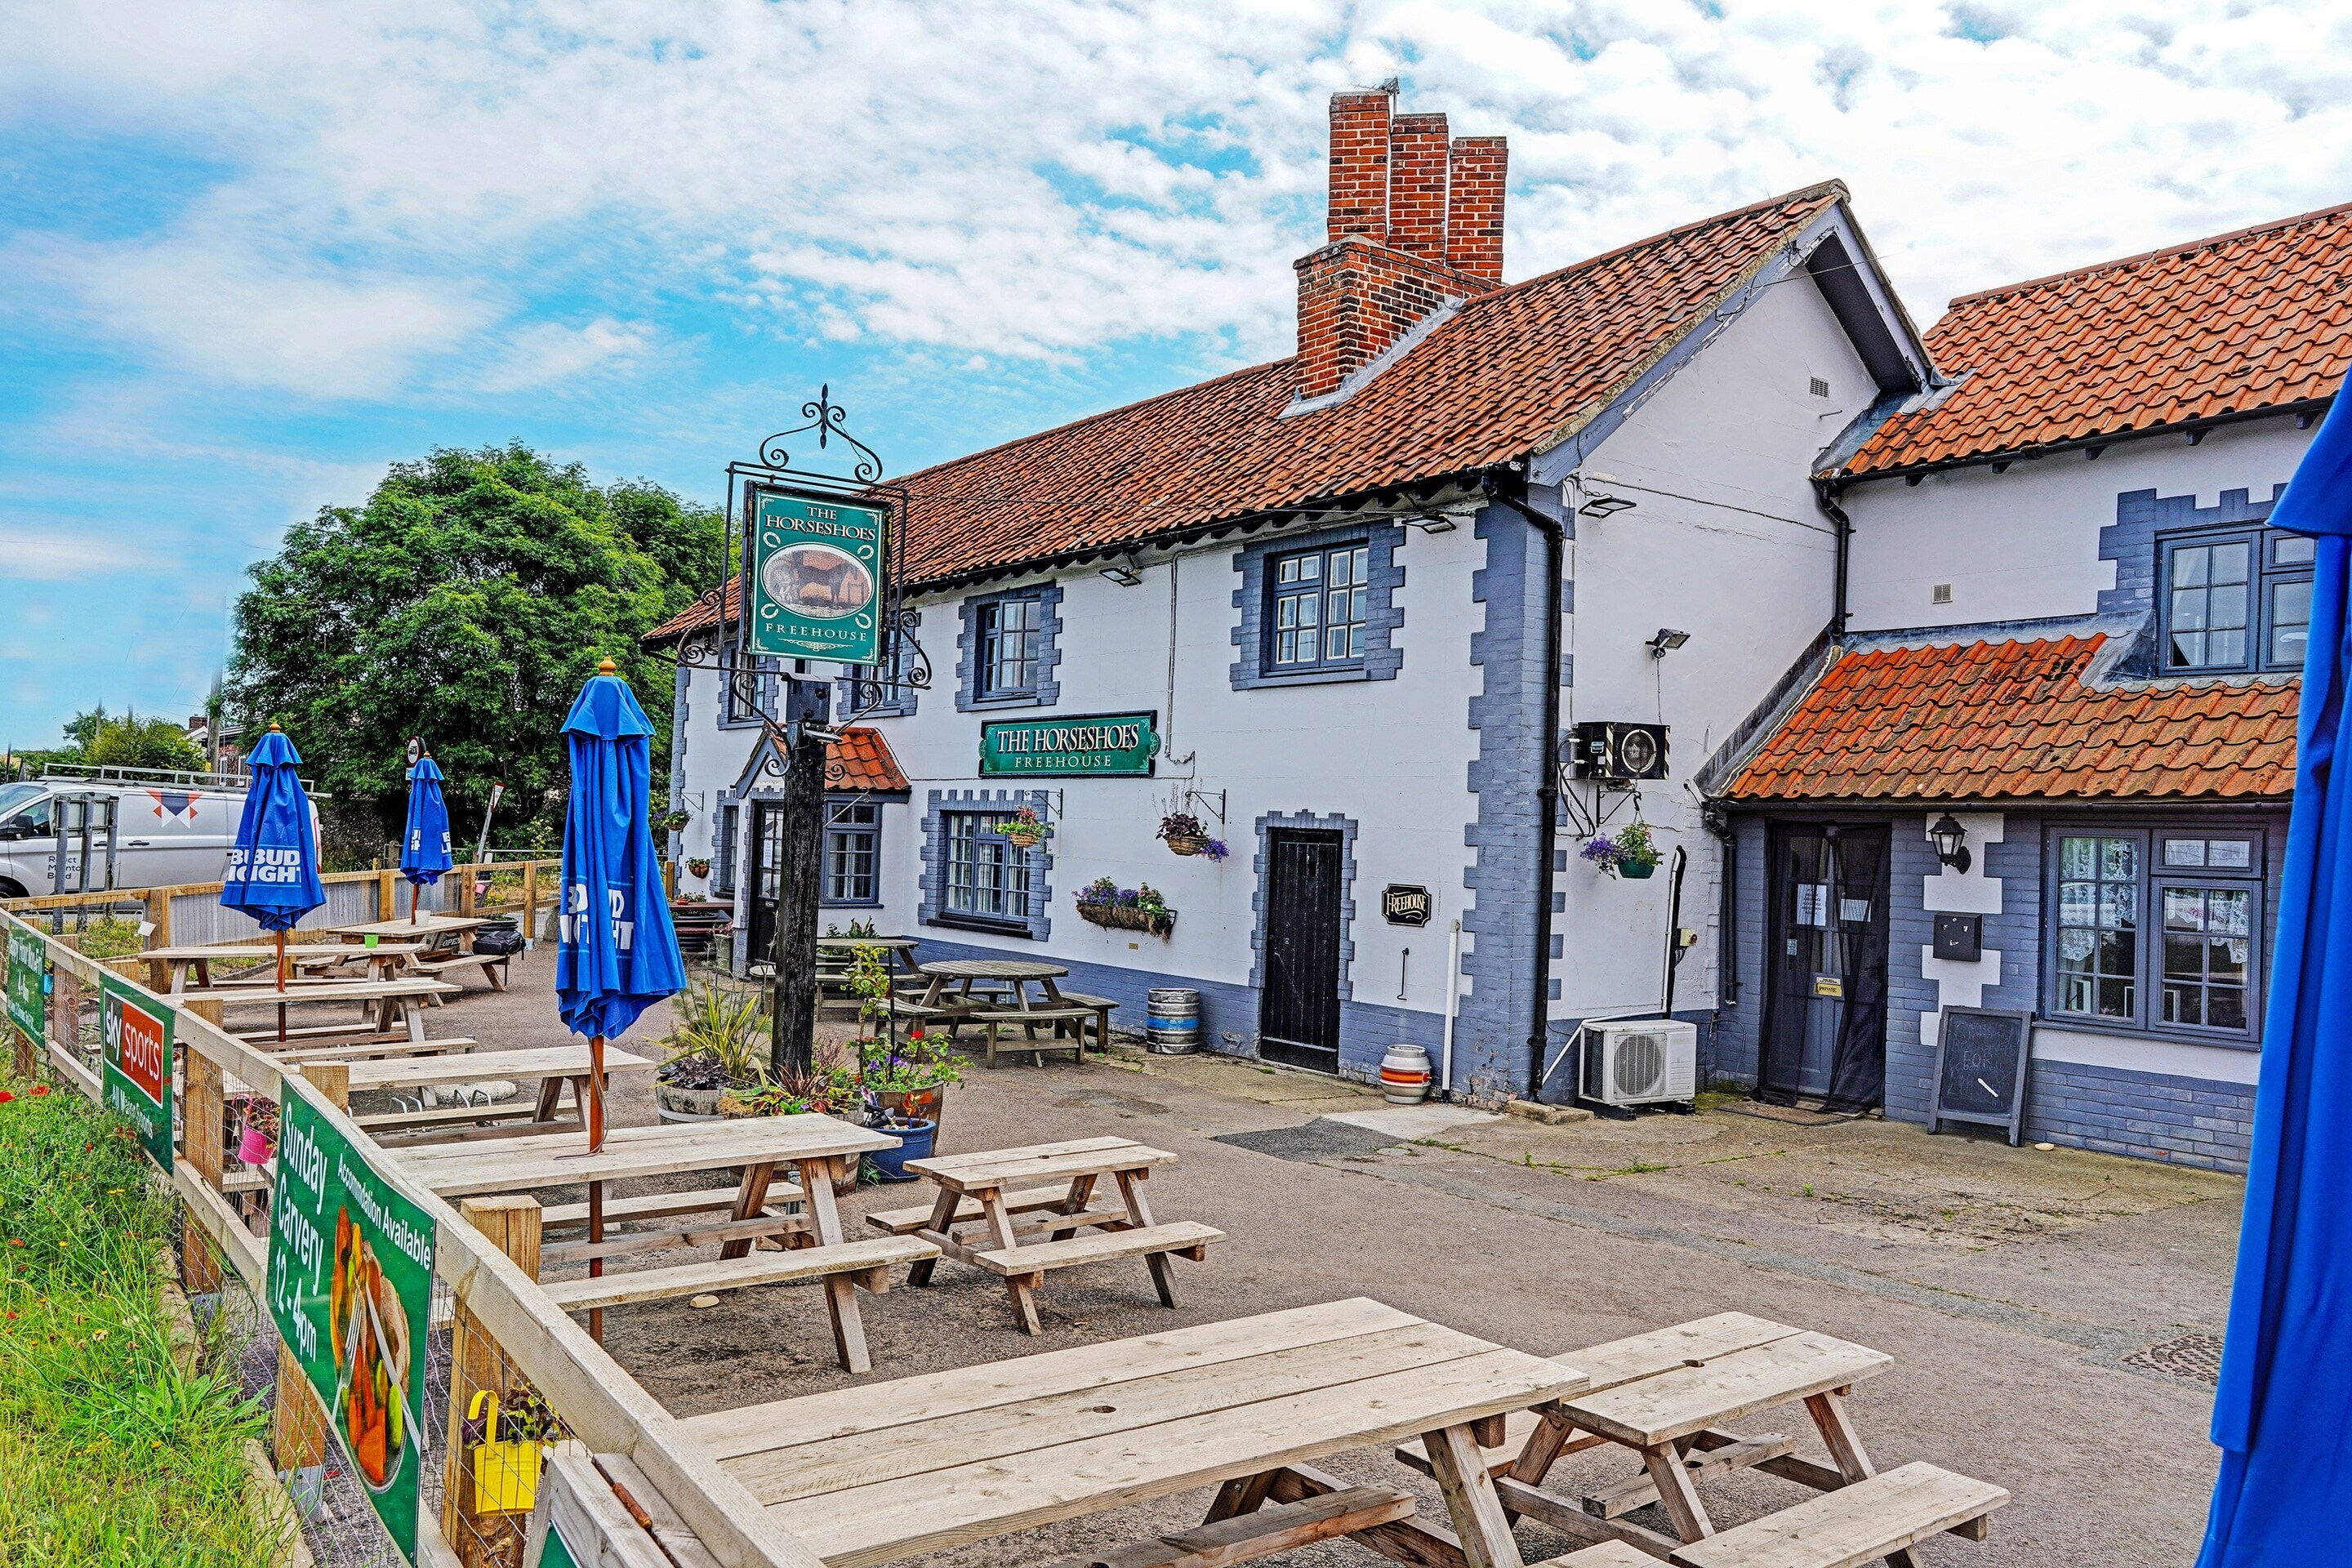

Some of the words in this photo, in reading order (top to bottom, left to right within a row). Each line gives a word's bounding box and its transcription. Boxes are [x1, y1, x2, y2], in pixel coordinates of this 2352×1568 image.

[764, 514, 876, 541] HORSESHOES
[807, 506, 837, 520] THE
[997, 730, 1030, 753] THE
[1033, 722, 1140, 752] HORSESHOES
[1385, 893, 1427, 916] FREEHOUSE
[105, 1001, 122, 1062] sky
[124, 1022, 160, 1081] sports
[283, 1101, 328, 1216] Sunday
[278, 1172, 324, 1297] Carvery
[381, 1205, 431, 1272] Available
